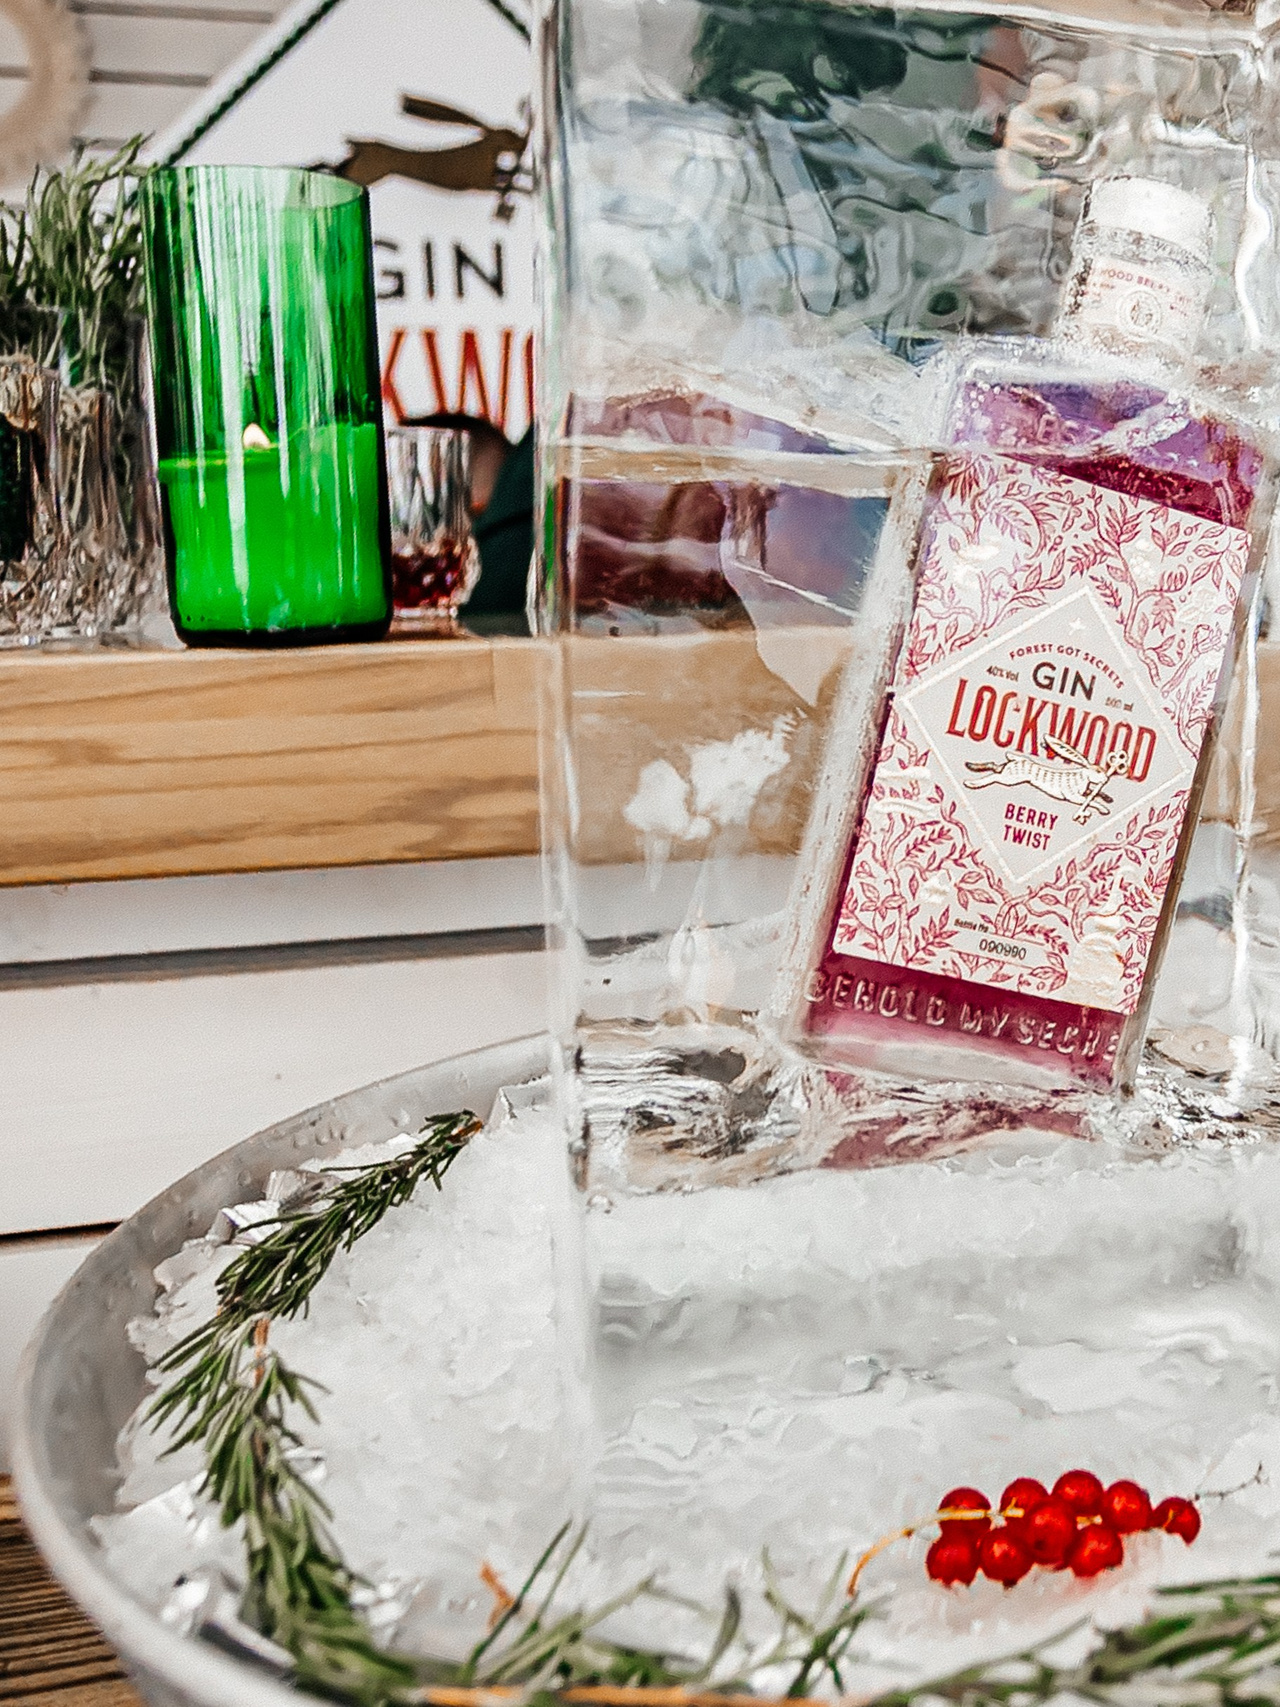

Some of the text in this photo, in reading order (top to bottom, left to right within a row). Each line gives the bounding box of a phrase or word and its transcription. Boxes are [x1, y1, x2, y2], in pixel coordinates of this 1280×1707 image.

[374, 239, 503, 300] GIN
[1009, 643, 1125, 689] FOREST GOT SECRETS
[1032, 661, 1096, 701] GIN
[945, 677, 1157, 782] LOCKWOOD
[1003, 824, 1051, 851] TWIST
[1004, 803, 1059, 831] BERRY
[803, 968, 947, 1027] BEHOLD
[959, 1002, 1010, 1038] MY
